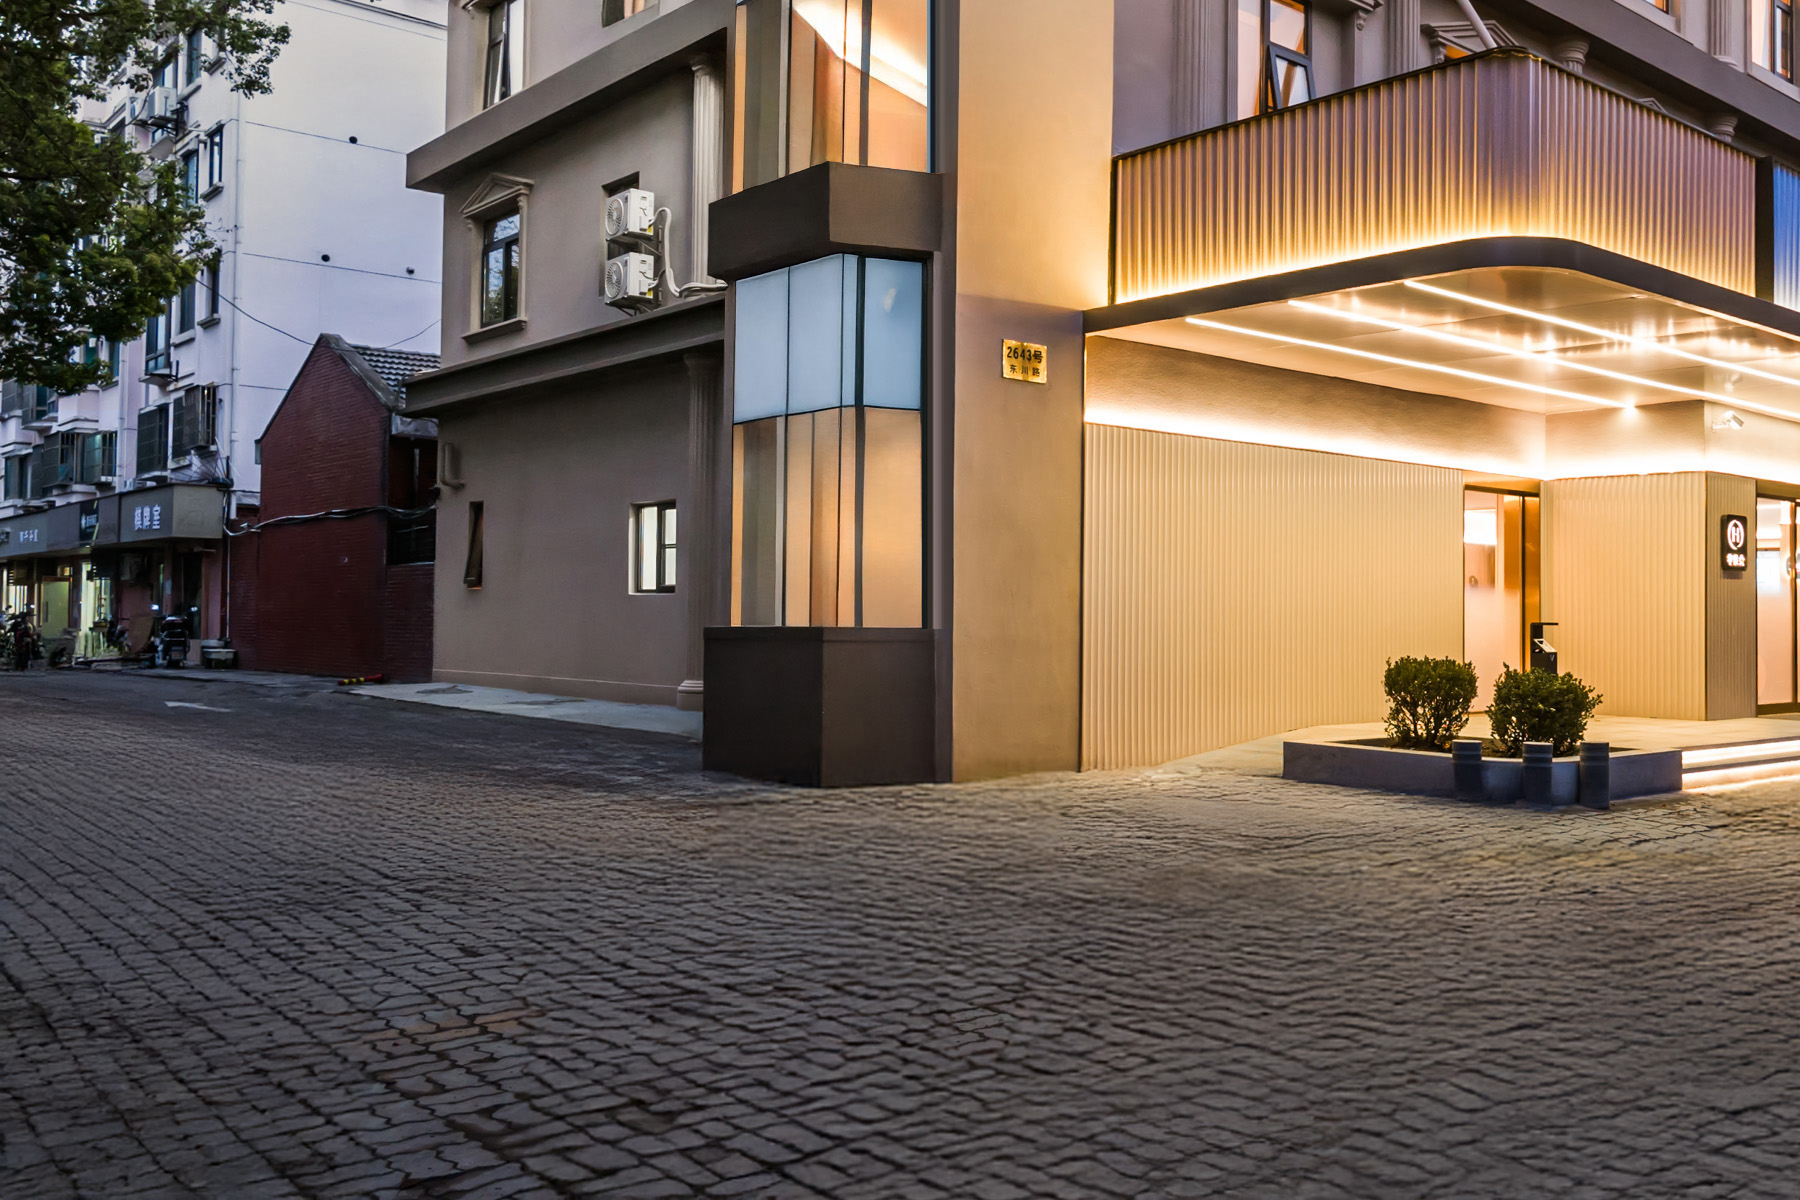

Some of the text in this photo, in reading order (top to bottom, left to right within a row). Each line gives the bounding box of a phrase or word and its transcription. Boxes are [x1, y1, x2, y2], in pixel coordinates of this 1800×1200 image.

[1007, 346, 1043, 363] 2643号
[1009, 364, 1040, 377] 东川路
